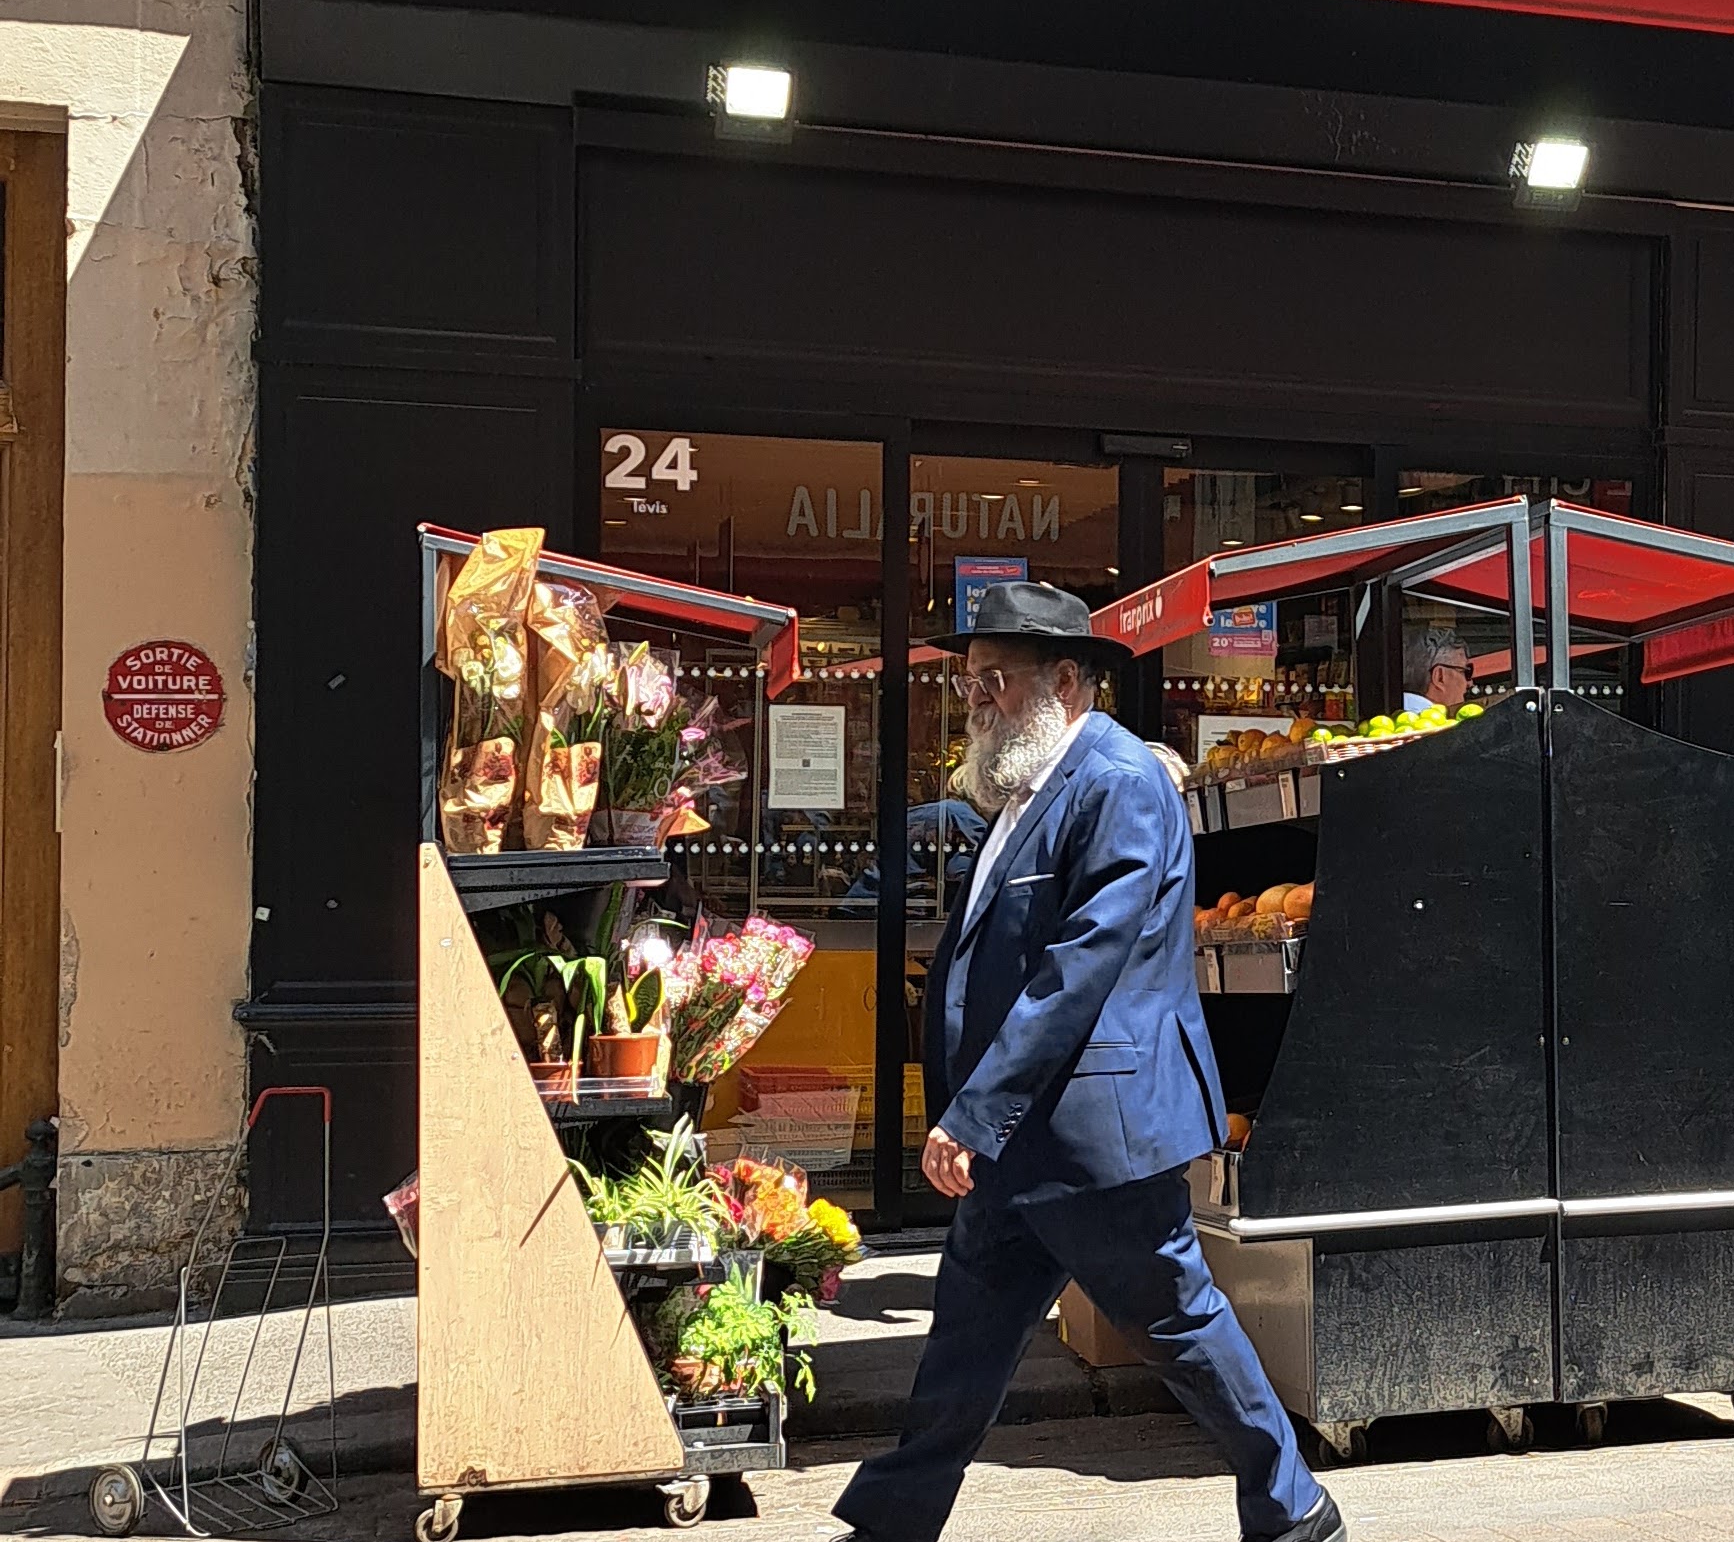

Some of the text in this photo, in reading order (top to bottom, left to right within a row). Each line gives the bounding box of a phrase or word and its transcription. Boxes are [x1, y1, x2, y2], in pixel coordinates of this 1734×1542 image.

[603, 433, 699, 491] 24
[125, 647, 204, 672] SORTIE
[154, 664, 174, 673] DE
[116, 675, 213, 690] VOITURE
[116, 714, 213, 747] STATIONNER
[154, 720, 175, 729] DE
